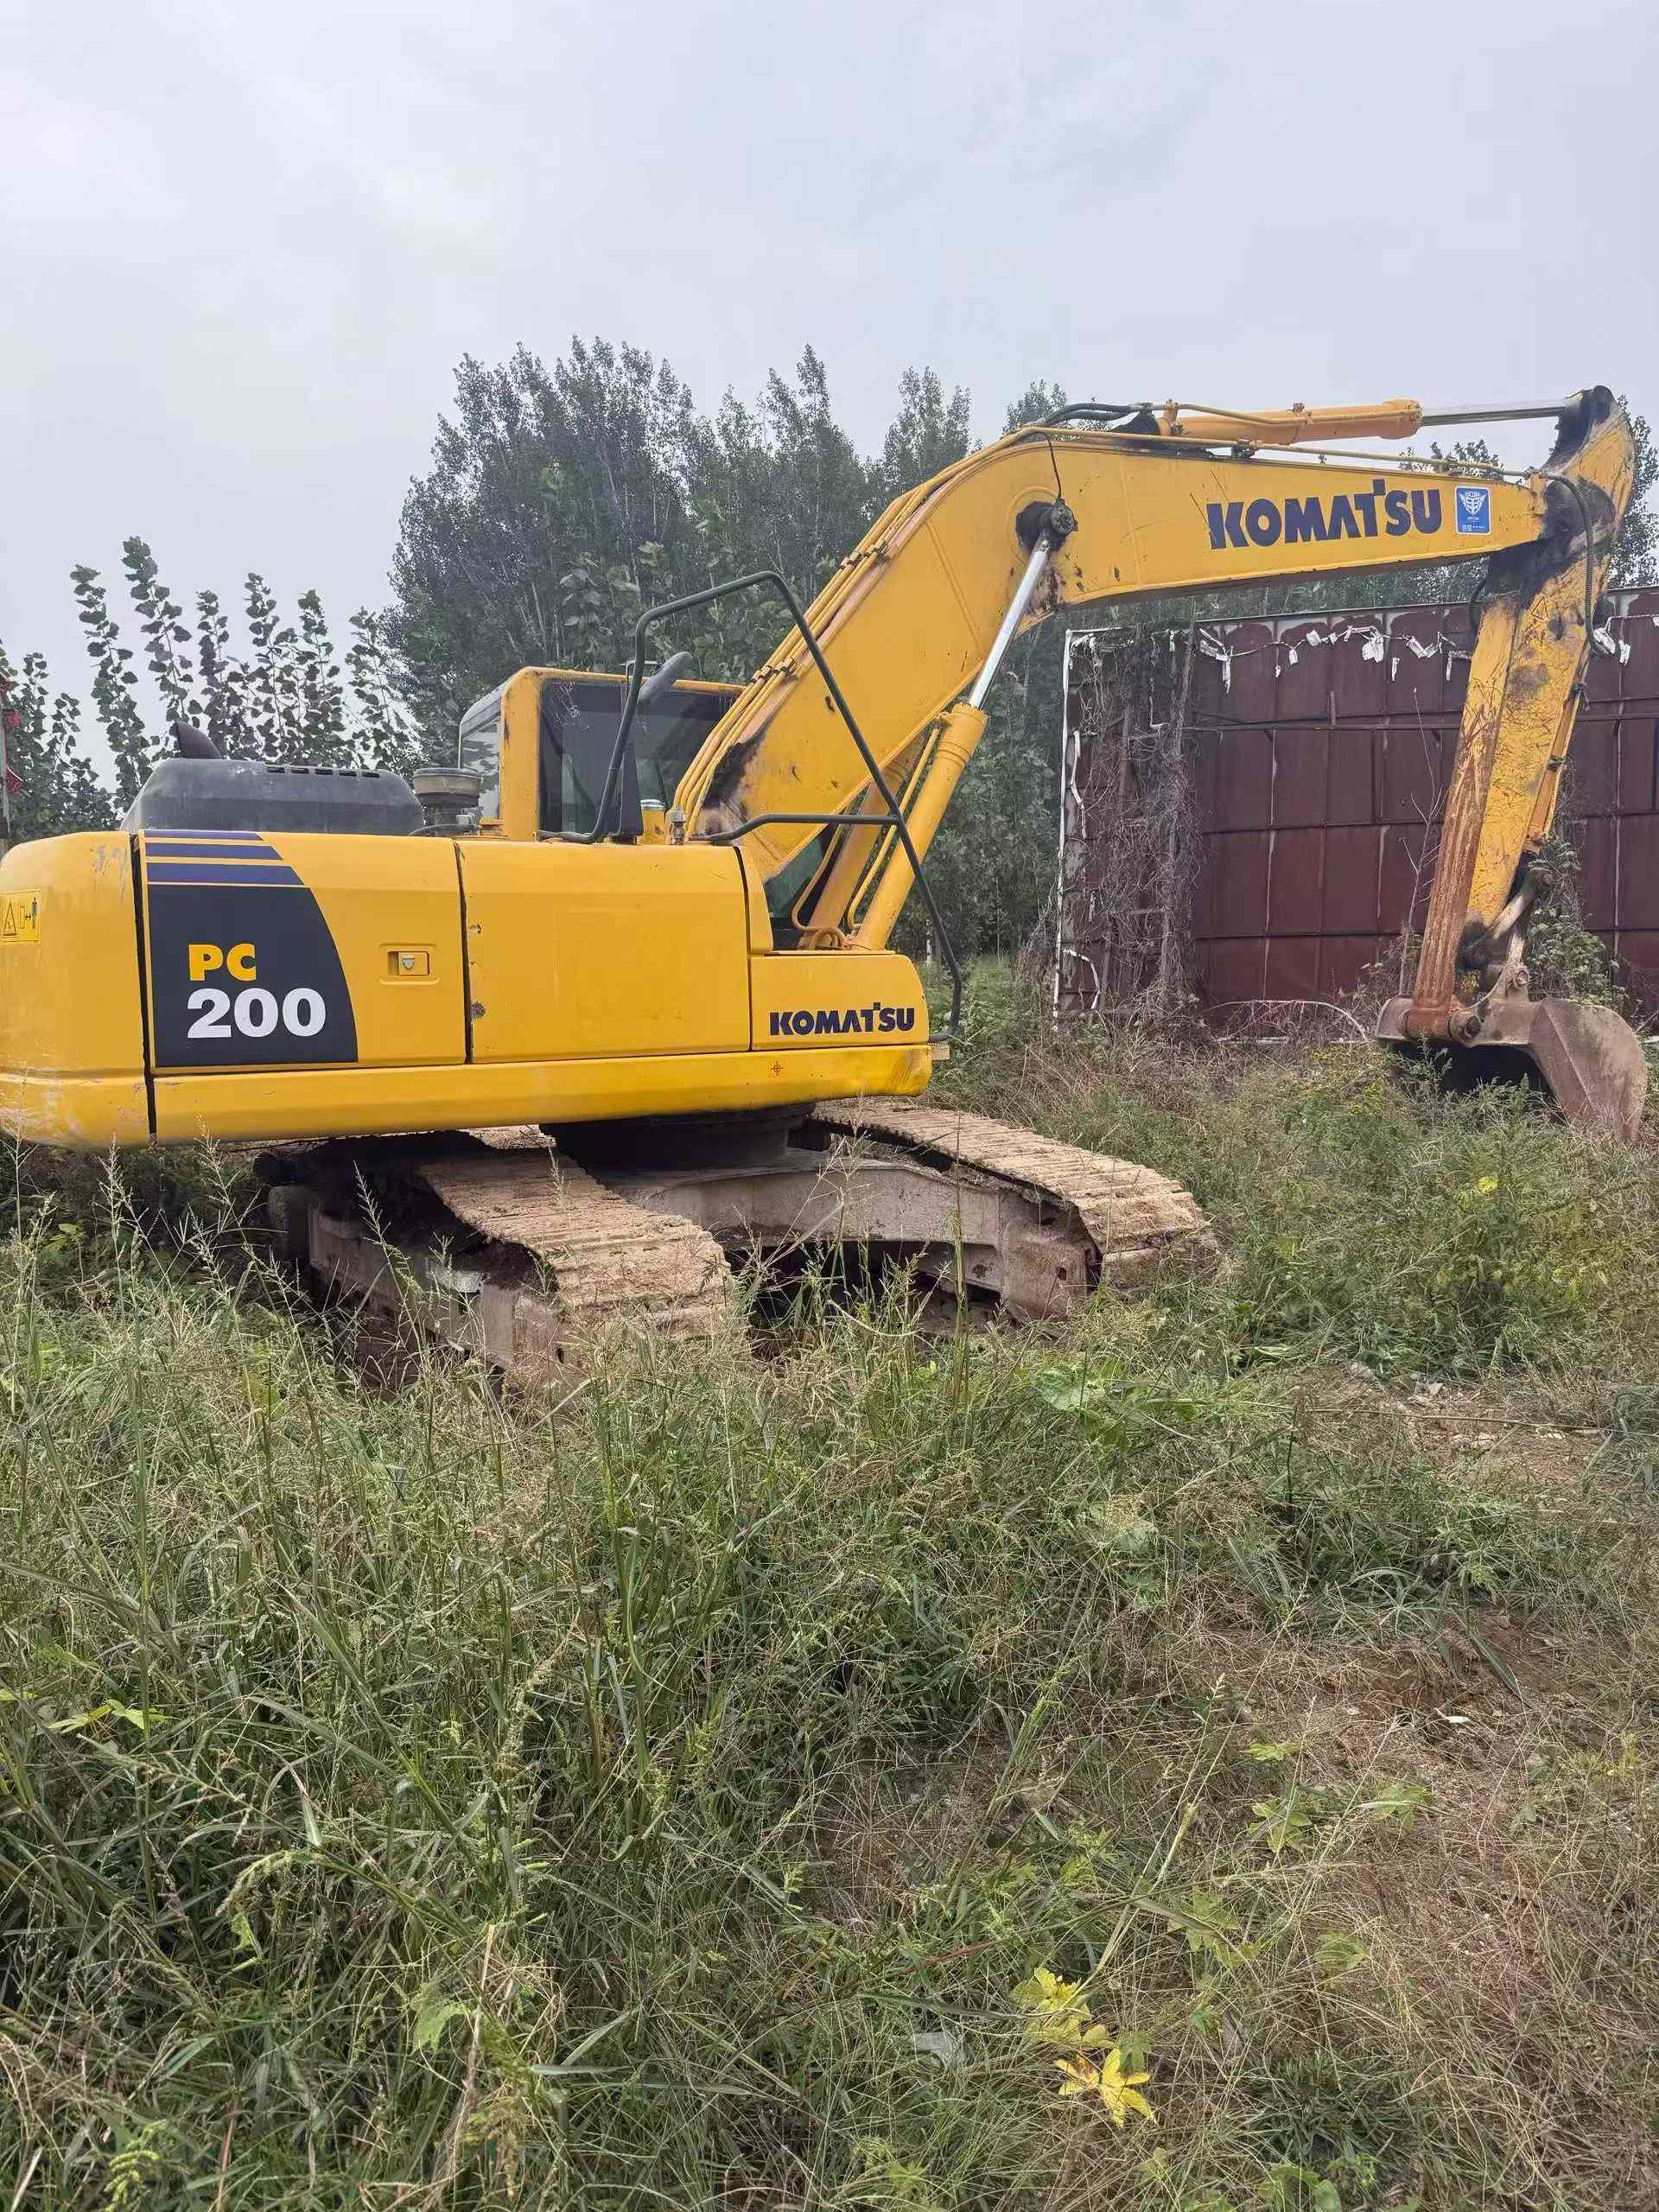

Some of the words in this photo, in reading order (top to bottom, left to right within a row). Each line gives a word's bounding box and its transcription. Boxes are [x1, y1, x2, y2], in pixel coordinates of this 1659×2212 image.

[1206, 478, 1443, 550] KOMATSU
[188, 943, 257, 982] PC
[187, 988, 327, 1039] 200
[769, 1001, 915, 1036] KOMATSU
